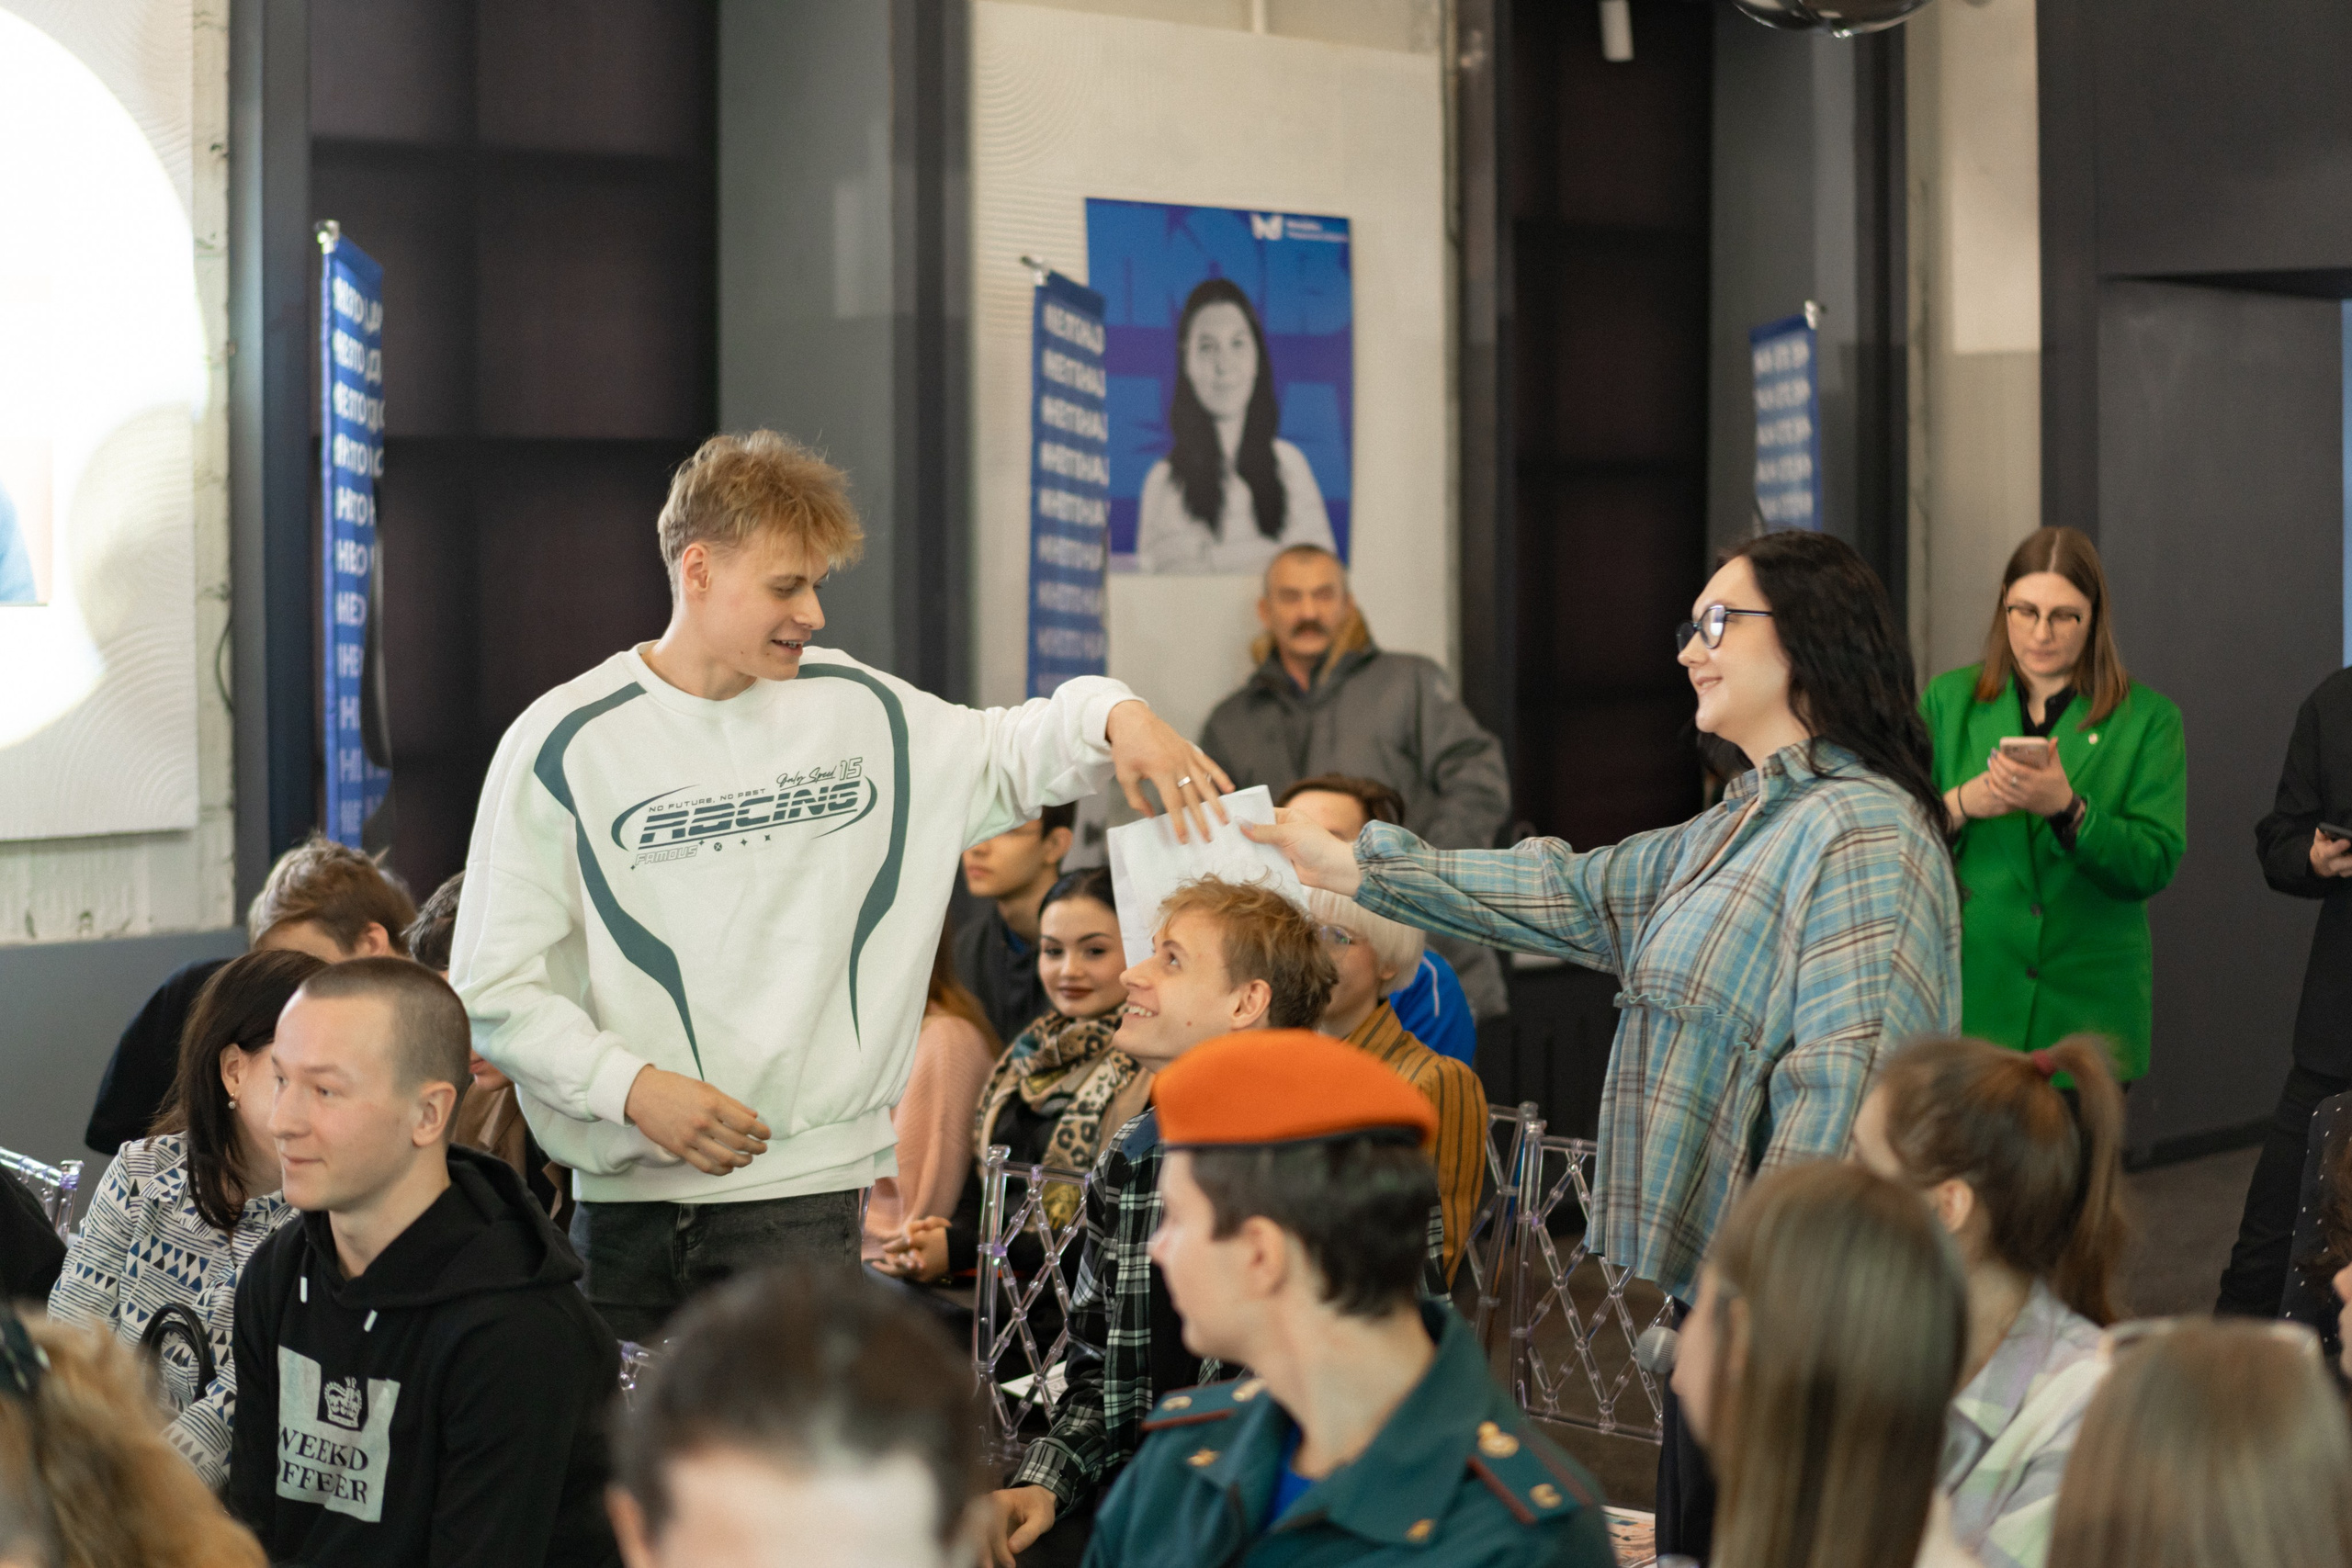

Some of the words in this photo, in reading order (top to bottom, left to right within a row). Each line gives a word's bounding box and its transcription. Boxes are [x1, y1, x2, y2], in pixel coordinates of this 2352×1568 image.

[840, 756, 863, 781] 15
[639, 781, 861, 844] RACING
[649, 805, 663, 813] NO
[719, 794, 734, 802] NO
[737, 788, 765, 798] PAST
[634, 845, 699, 866] FAMOUS
